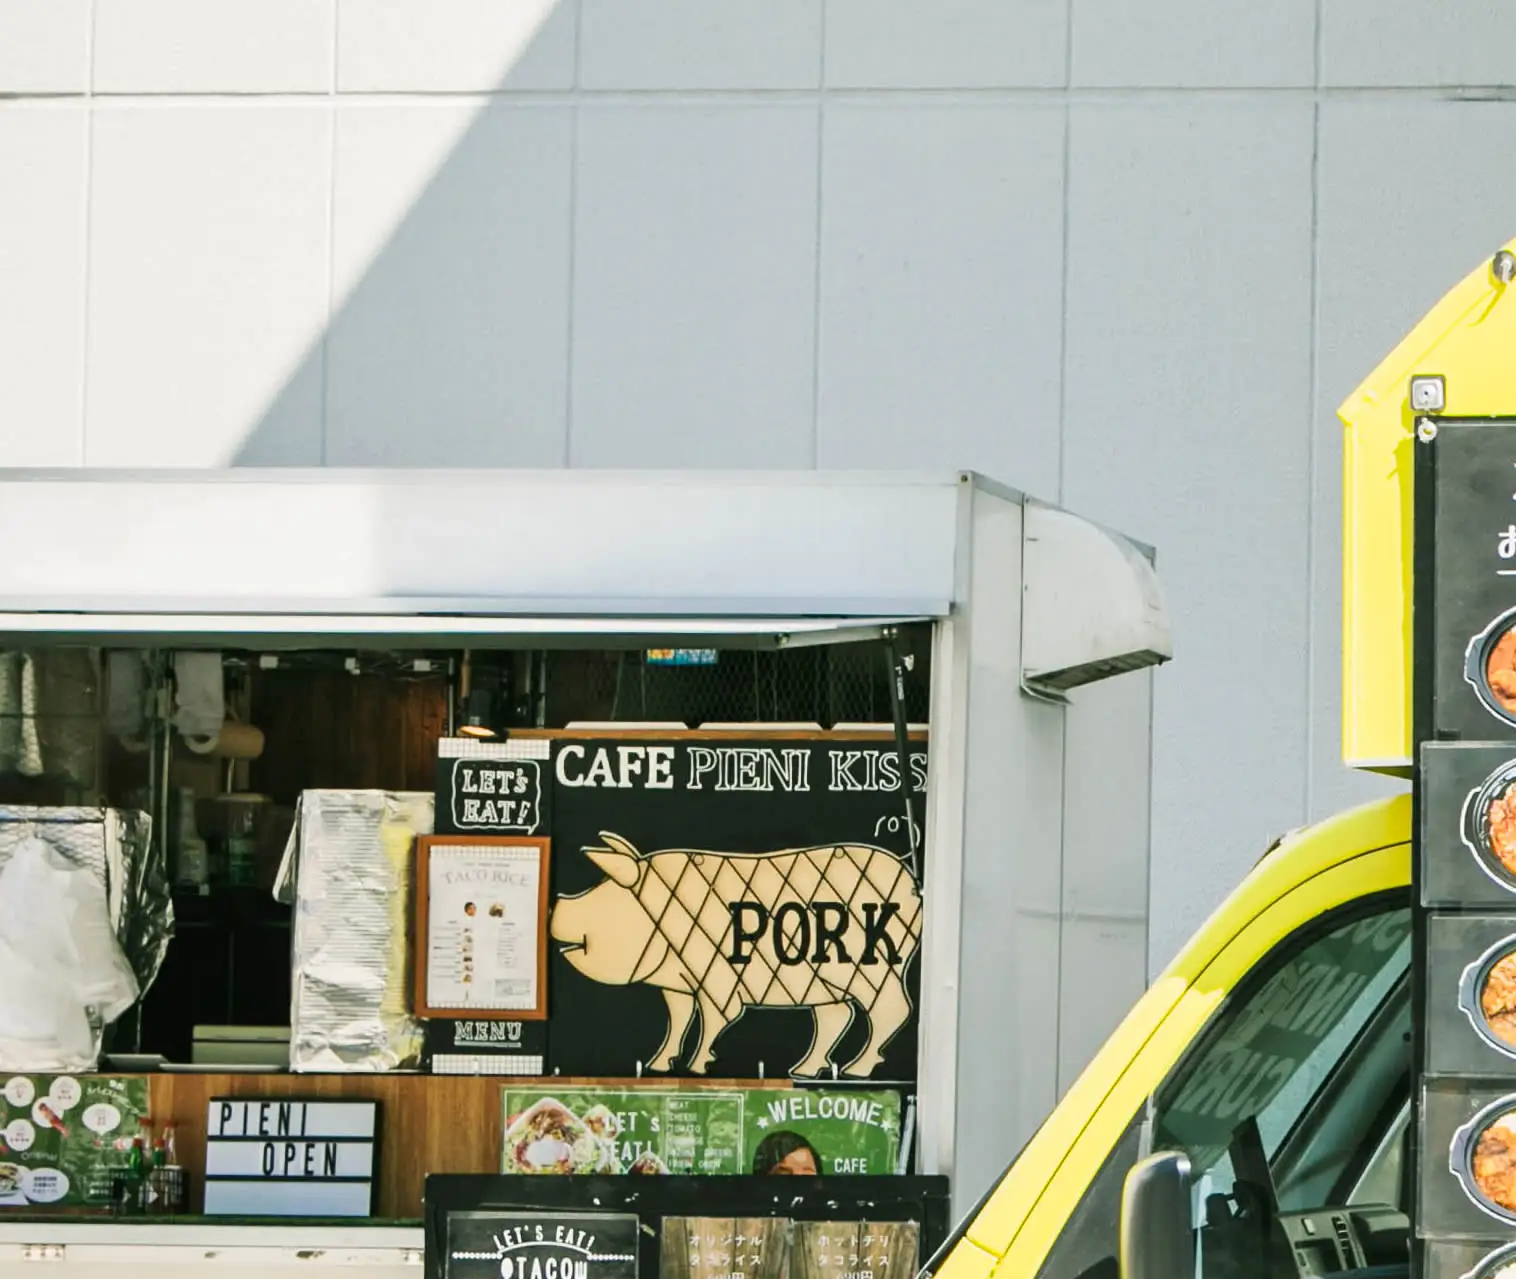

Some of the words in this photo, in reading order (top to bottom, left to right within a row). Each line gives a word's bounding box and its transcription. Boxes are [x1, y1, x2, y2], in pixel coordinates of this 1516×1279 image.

[555, 745, 675, 790] CAFE
[686, 746, 811, 791] PIENI
[462, 798, 531, 825] EAT!
[727, 901, 903, 968] PORK
[453, 1021, 523, 1042] MENU
[219, 1102, 308, 1137] PIENI
[767, 1096, 884, 1128] WELCOME
[262, 1141, 339, 1177] OPEN
[833, 1158, 868, 1174] CAFE
[492, 1225, 544, 1251] LET'S
[555, 1225, 596, 1251] EAT!
[690, 1235, 763, 1247] オリジナル
[818, 1255, 889, 1266] タコライス
